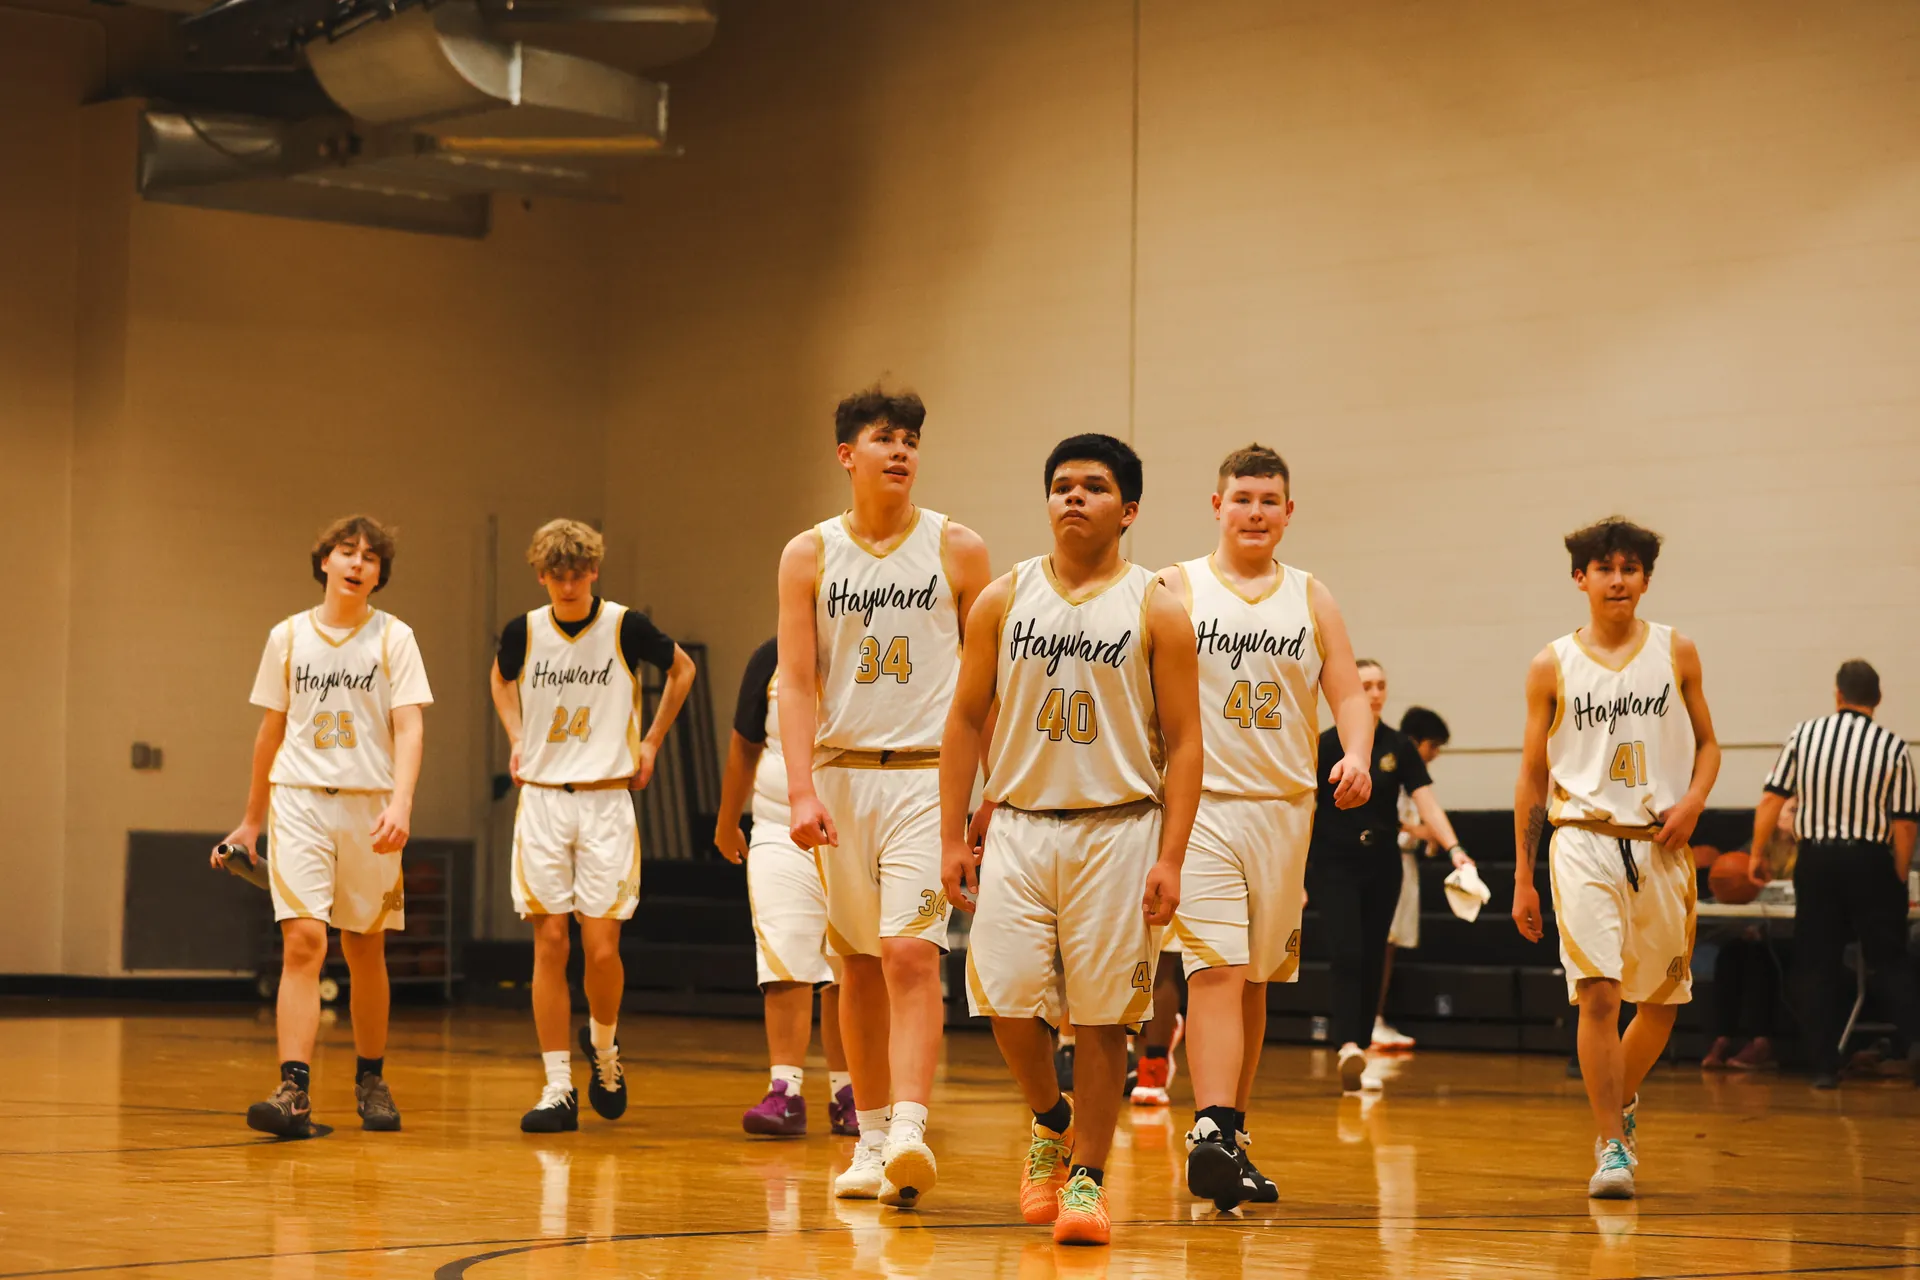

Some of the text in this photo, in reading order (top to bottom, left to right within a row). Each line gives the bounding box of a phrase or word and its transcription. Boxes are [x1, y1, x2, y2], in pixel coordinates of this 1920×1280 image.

[828, 574, 938, 628] Hayward
[854, 635, 912, 684] 34
[1010, 617, 1132, 678] Hayward
[1197, 618, 1306, 671] Hayward
[295, 663, 378, 703] Hayward
[533, 657, 614, 697] Hayward
[546, 705, 592, 743] 24
[1036, 688, 1098, 744] 40
[1223, 680, 1282, 730] 42
[1574, 683, 1670, 735] Hayward
[313, 710, 358, 750] 25
[1609, 740, 1648, 788] 41
[917, 888, 948, 922] 34
